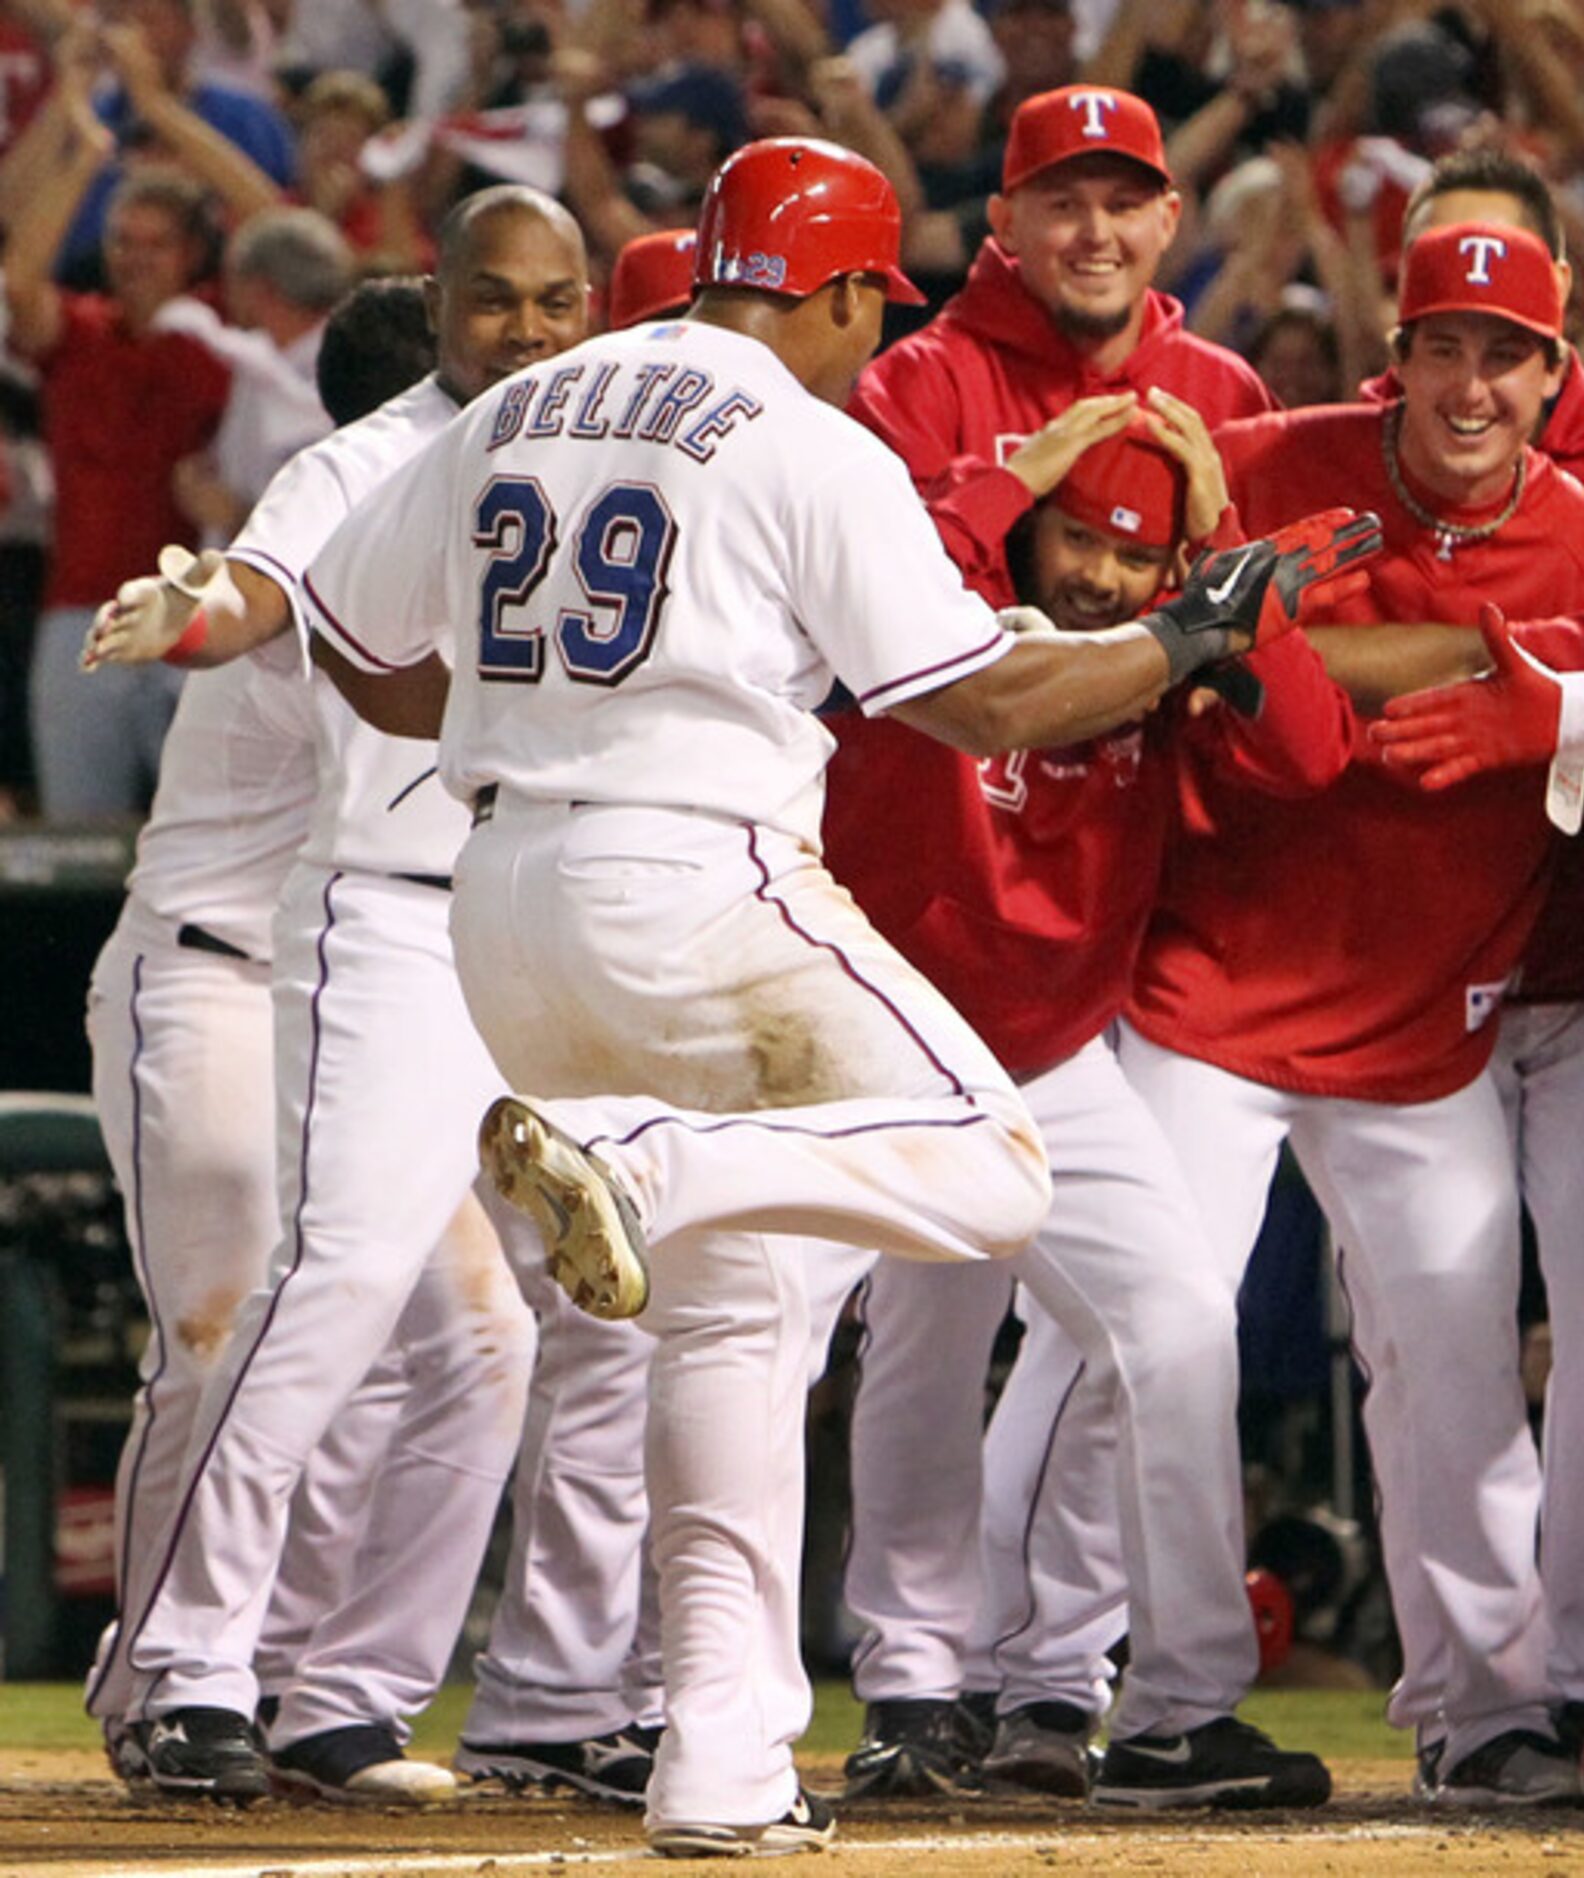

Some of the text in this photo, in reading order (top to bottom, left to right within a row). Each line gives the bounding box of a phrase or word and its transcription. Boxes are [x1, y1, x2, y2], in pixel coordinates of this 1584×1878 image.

[1068, 91, 1118, 139] T
[745, 251, 788, 288] 29
[1459, 235, 1508, 287] T
[486, 361, 765, 465] BELTRE
[470, 472, 681, 688] 29
